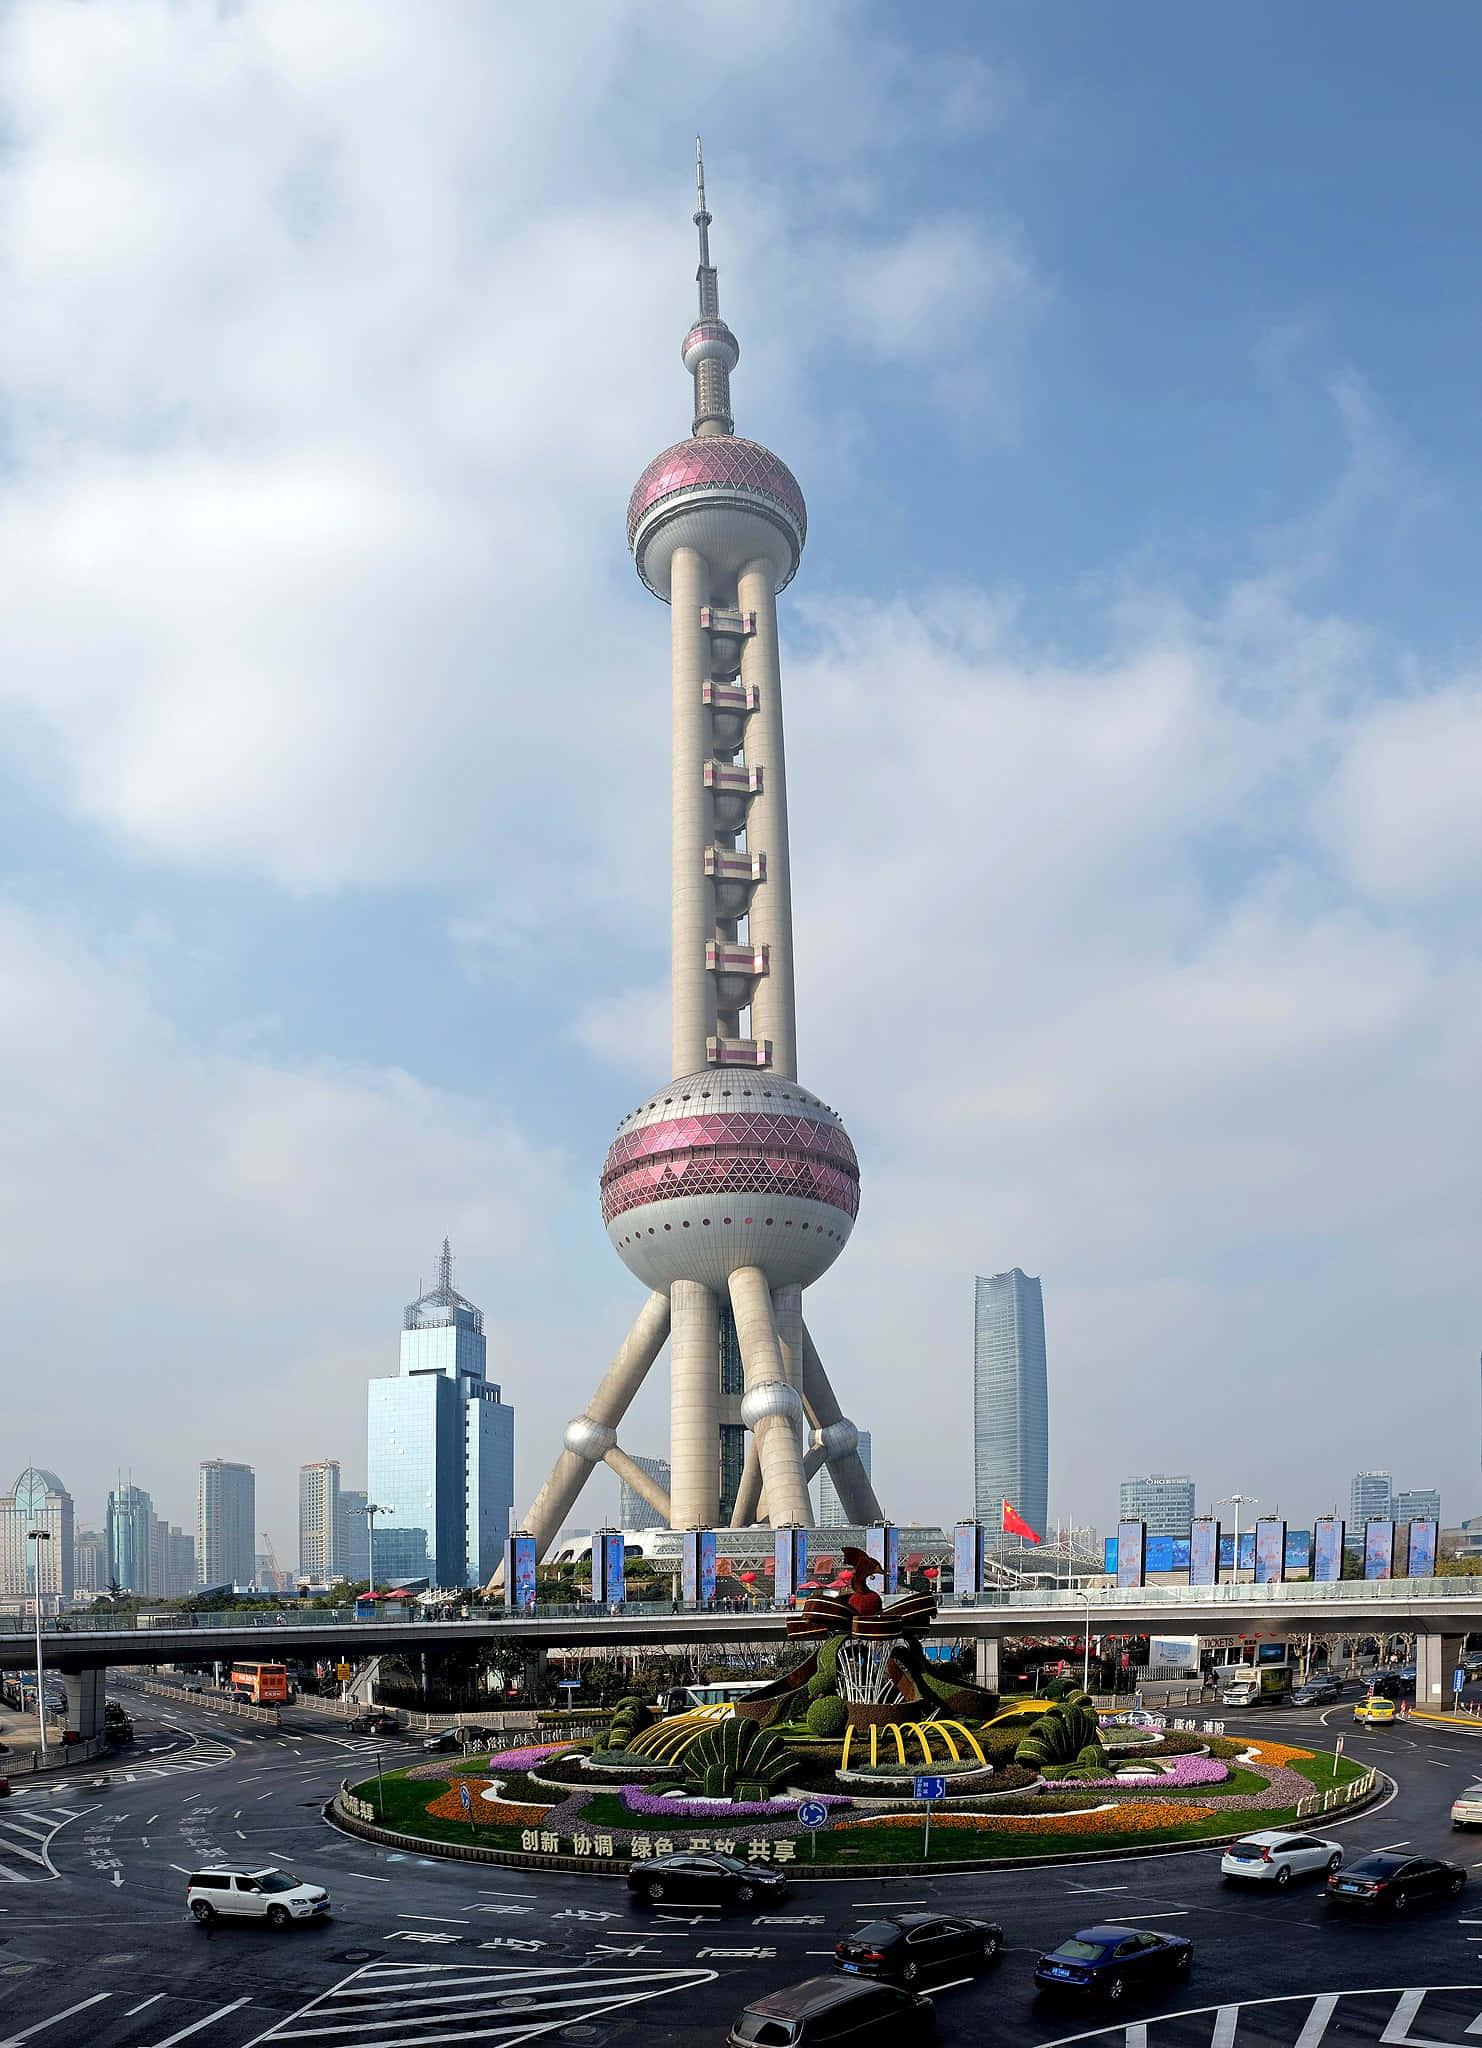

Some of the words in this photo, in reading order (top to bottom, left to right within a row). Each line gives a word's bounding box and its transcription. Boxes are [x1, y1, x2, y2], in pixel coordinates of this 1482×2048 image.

[1204, 1638, 1234, 1649] TICKETS
[521, 1829, 559, 1853] 创新
[572, 1833, 613, 1857] 协调
[630, 1836, 674, 1859] 绿色
[748, 1839, 797, 1863] 共享
[460, 1903, 825, 1925] 世纪大道
[382, 1931, 776, 1958] 世纪大道
